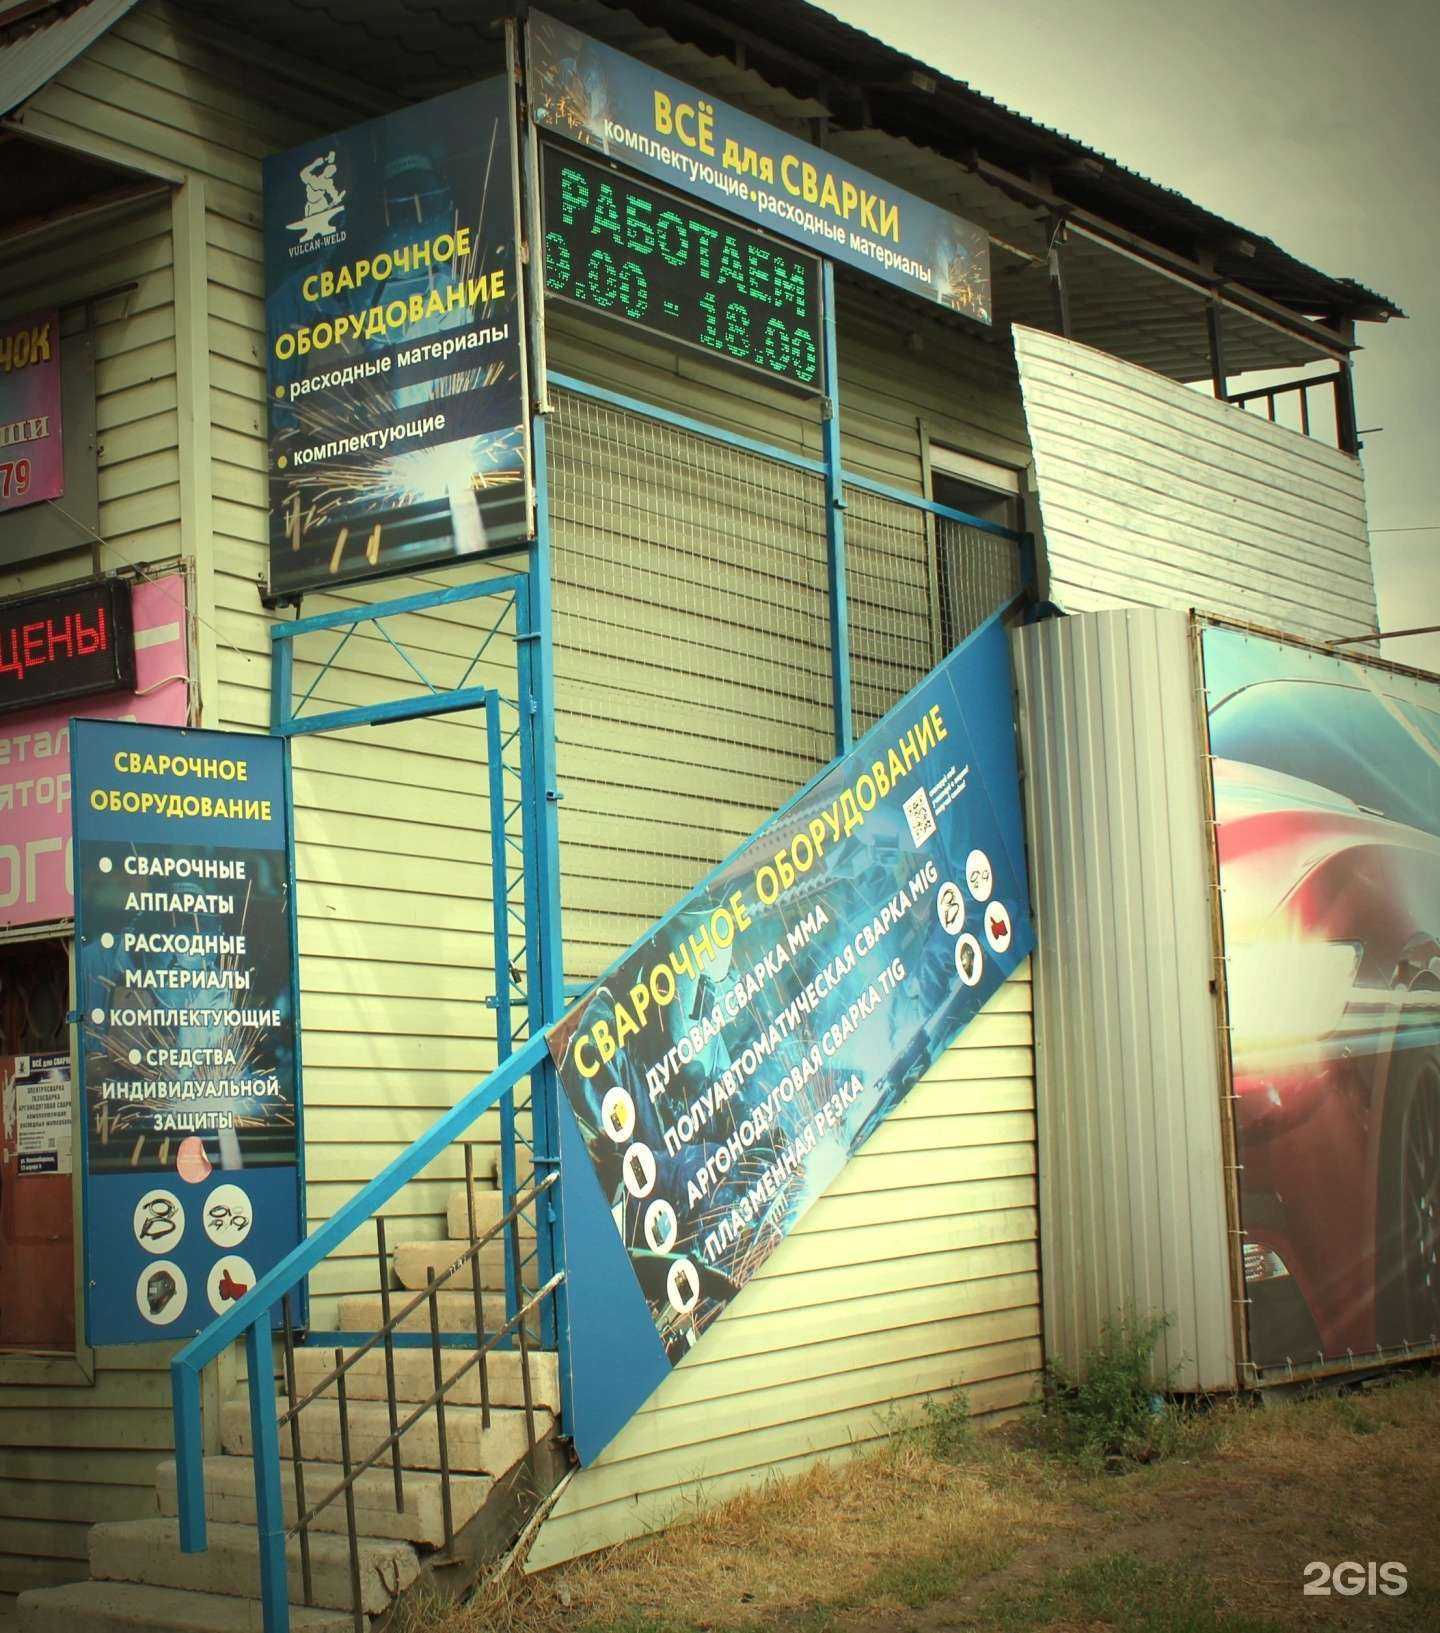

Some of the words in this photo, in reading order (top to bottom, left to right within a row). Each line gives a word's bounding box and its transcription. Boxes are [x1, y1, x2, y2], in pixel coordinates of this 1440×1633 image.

[603, 118, 749, 200] комплектующие
[758, 192, 846, 246] расходные
[849, 235, 932, 284] материалы
[654, 90, 715, 157] ВСЁ
[723, 138, 774, 185] для
[780, 154, 901, 243] СВАРКИ
[302, 227, 472, 302] СВАРОЧНОЕ
[561, 167, 806, 318] РАБОТАЕМ
[275, 269, 506, 361] ОБОРУДОВАНИЕ
[699, 291, 816, 382] 18.00
[289, 353, 391, 402] расходные
[396, 323, 509, 372] материалы
[293, 412, 446, 466] комплектующие
[0, 608, 106, 680] ЦЕНЫ
[114, 751, 248, 782] СВАРОЧНОЕ
[90, 790, 272, 821] ОБОРУДОВАНИЕ
[124, 856, 246, 880] СВАРОЧНЫЕ
[125, 892, 234, 914] АППАРАТЫ
[573, 890, 752, 1079] СВАРОЧНОЕ
[755, 704, 948, 905] ОБОРУДОВАНИЕ
[124, 933, 246, 956] РАСХОДНЫЕ
[125, 970, 250, 989] МАТЕРИАЛЫ
[110, 1008, 281, 1031] КОМПЛЕКТУЮЩИЕ
[645, 1009, 726, 1104] ДУГОВАЯ
[725, 944, 790, 1016] СВАРКА
[663, 944, 857, 1158] ПОЛУАВТОМАТИЧЕСКАЯ
[854, 890, 912, 957] СВАРКА
[909, 860, 938, 902] MIG
[102, 1076, 279, 1100] ИНДИВИДУАЛЬНОЙ
[146, 1048, 236, 1068] СРЕДСТВА
[687, 1043, 823, 1209] АРГОНОДУГОВАЯ
[822, 986, 881, 1057] СВАРКА
[878, 958, 906, 991] TIG
[153, 1112, 232, 1132] ЗАЩИТЫ
[704, 1123, 818, 1262] ПЛАЗМЕННАЯ
[814, 1074, 864, 1137] РЕЗКА
